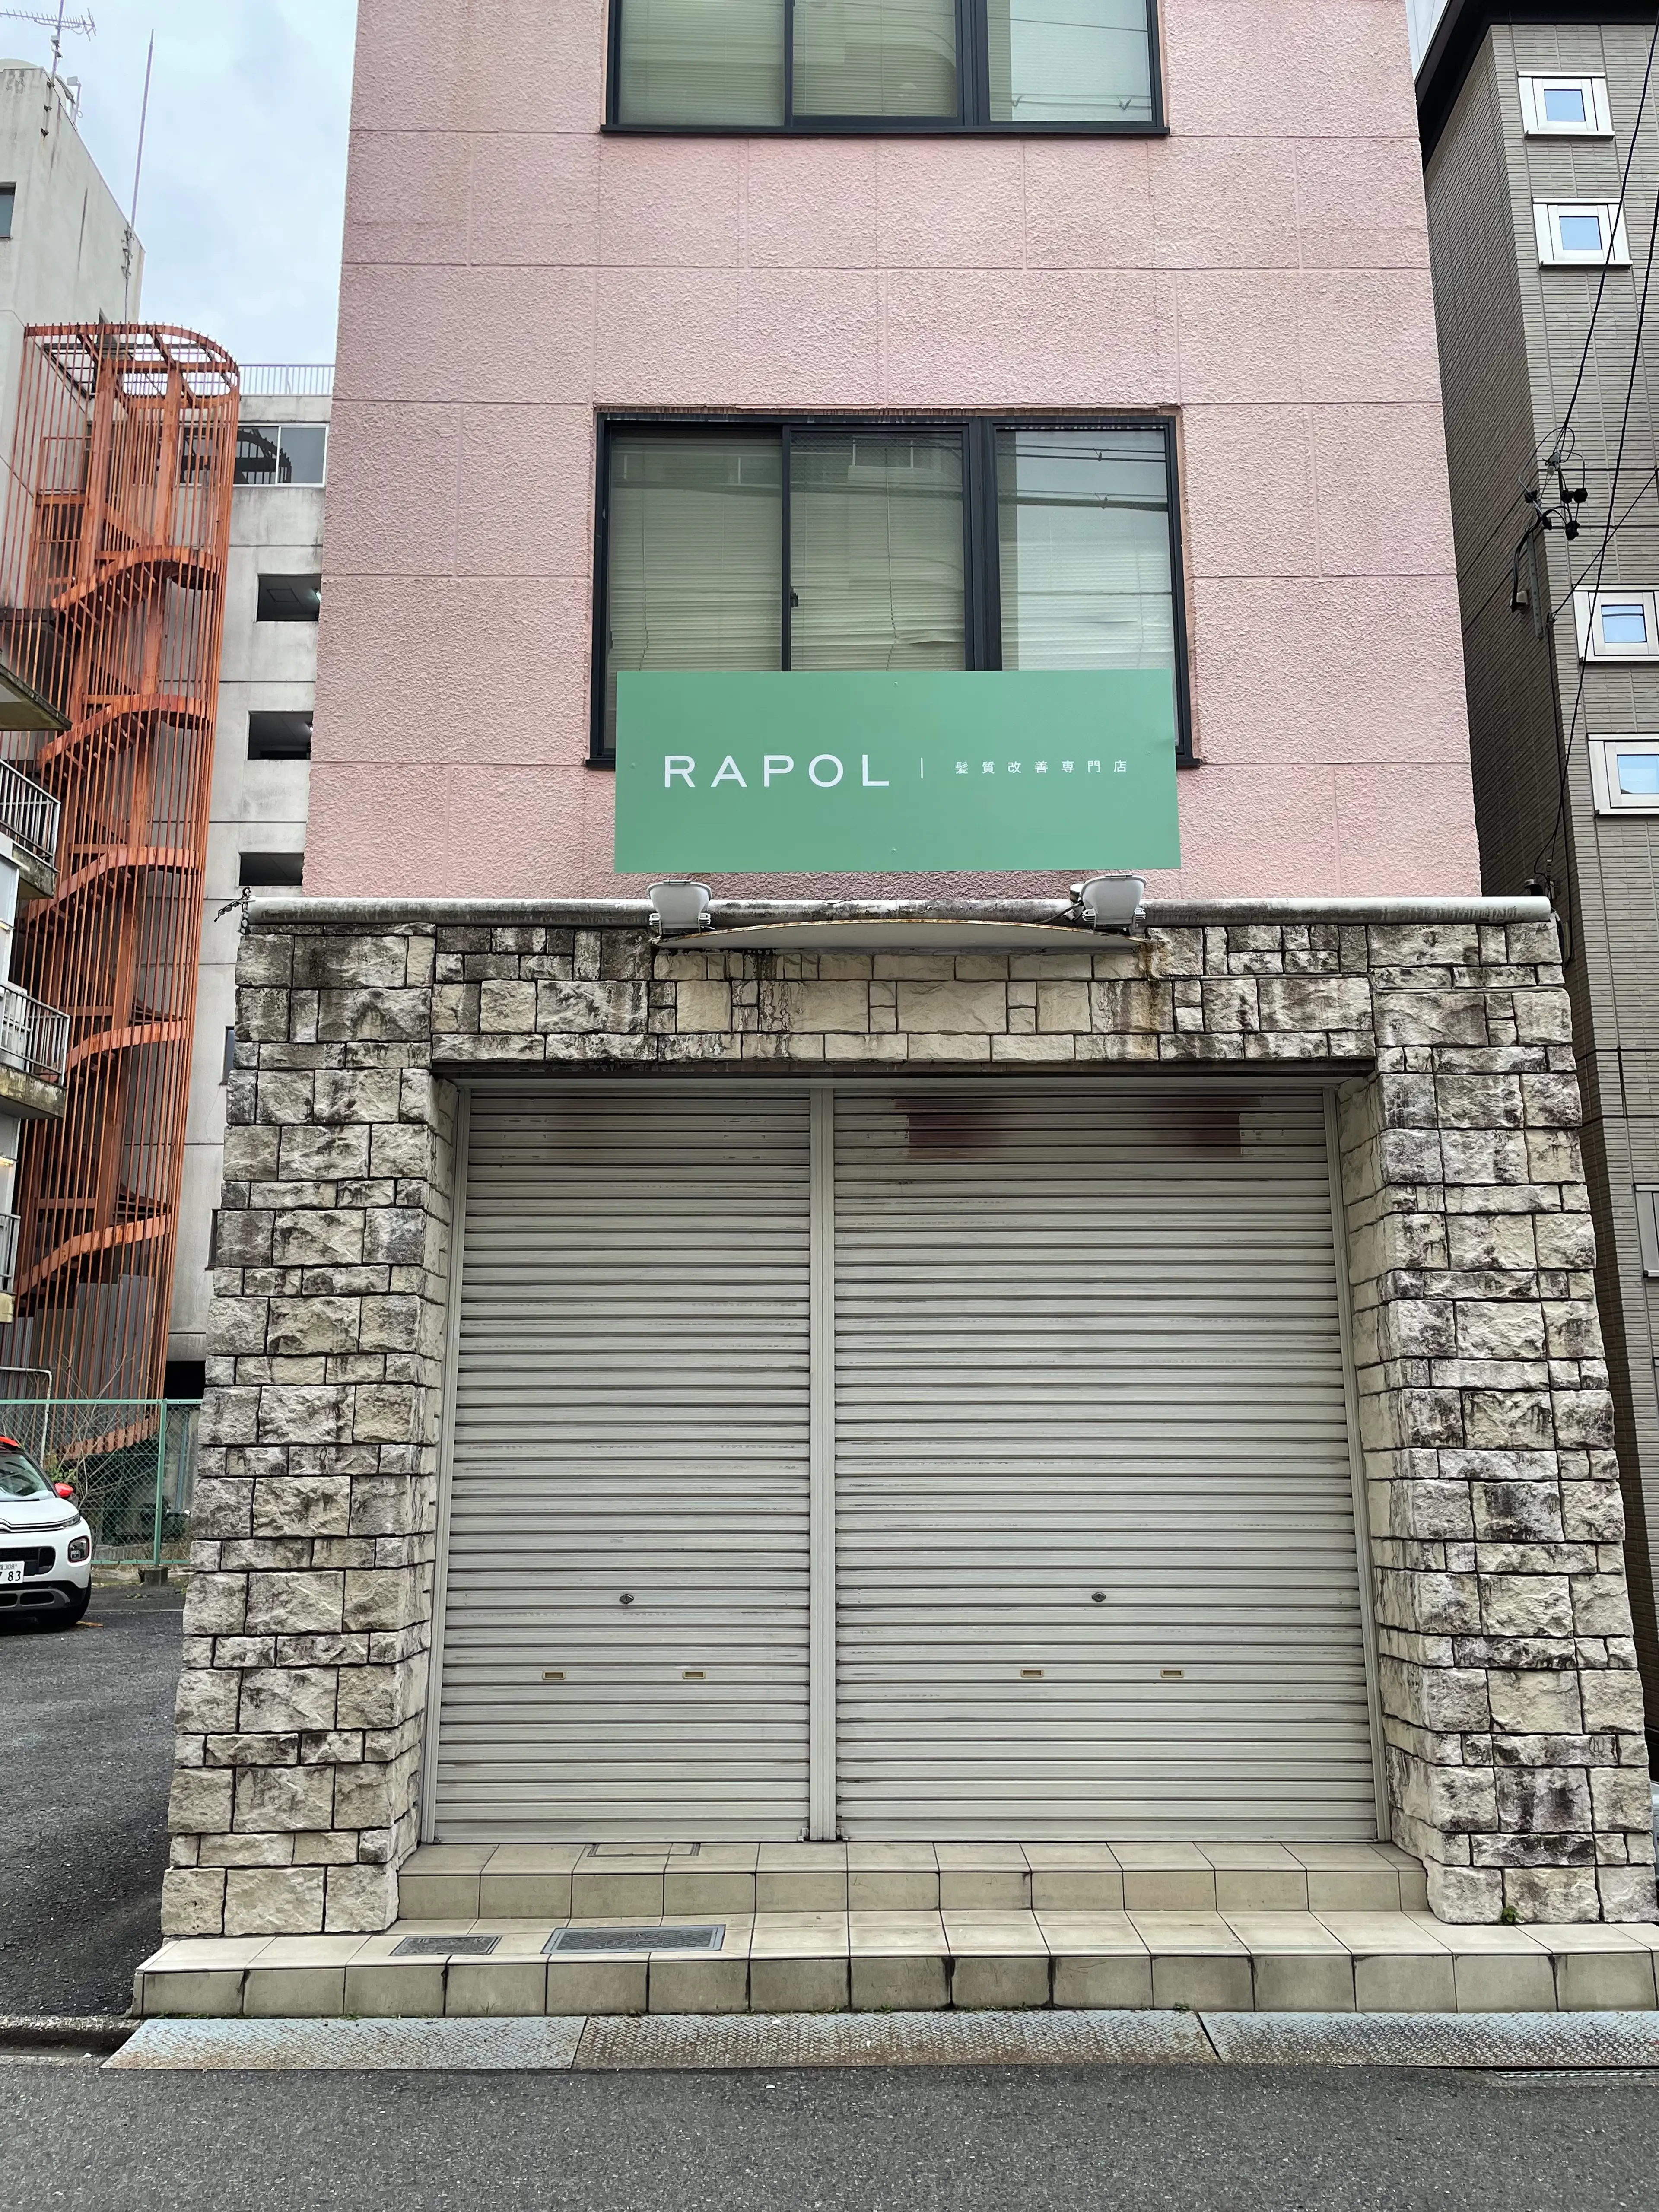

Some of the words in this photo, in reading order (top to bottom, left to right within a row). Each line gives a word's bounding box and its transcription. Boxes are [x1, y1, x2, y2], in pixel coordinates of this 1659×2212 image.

[664, 754, 890, 788] RAPOL
[955, 760, 1127, 774] 髪質改善専門店
